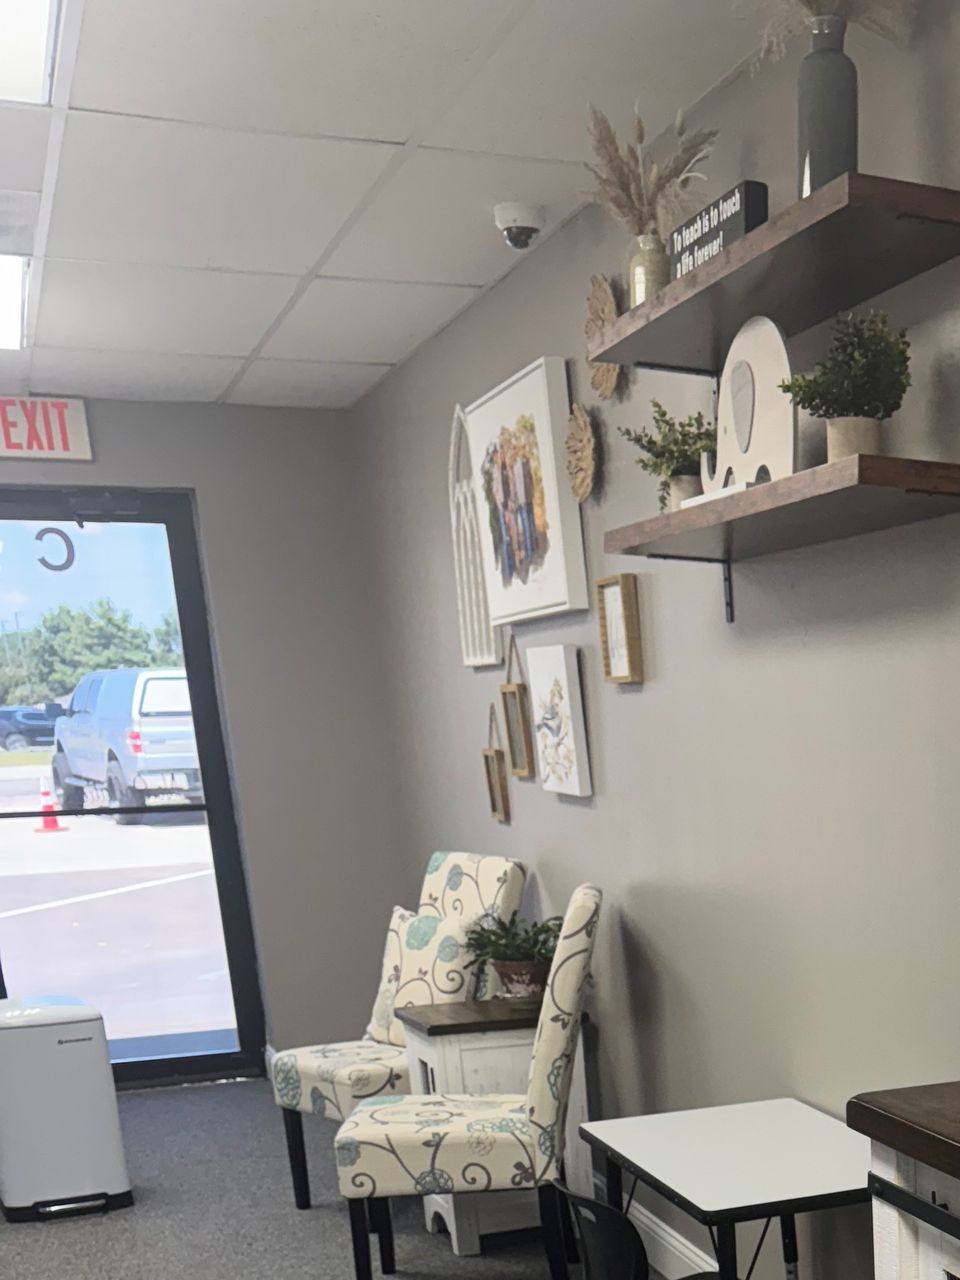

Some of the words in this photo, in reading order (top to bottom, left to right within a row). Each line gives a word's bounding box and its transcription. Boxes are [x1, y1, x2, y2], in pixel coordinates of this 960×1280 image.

[673, 231, 682, 254] To
[683, 216, 701, 248] teach
[702, 211, 709, 234] is
[710, 206, 718, 228] to
[719, 188, 740, 222] touch
[0, 399, 71, 452] EXIT
